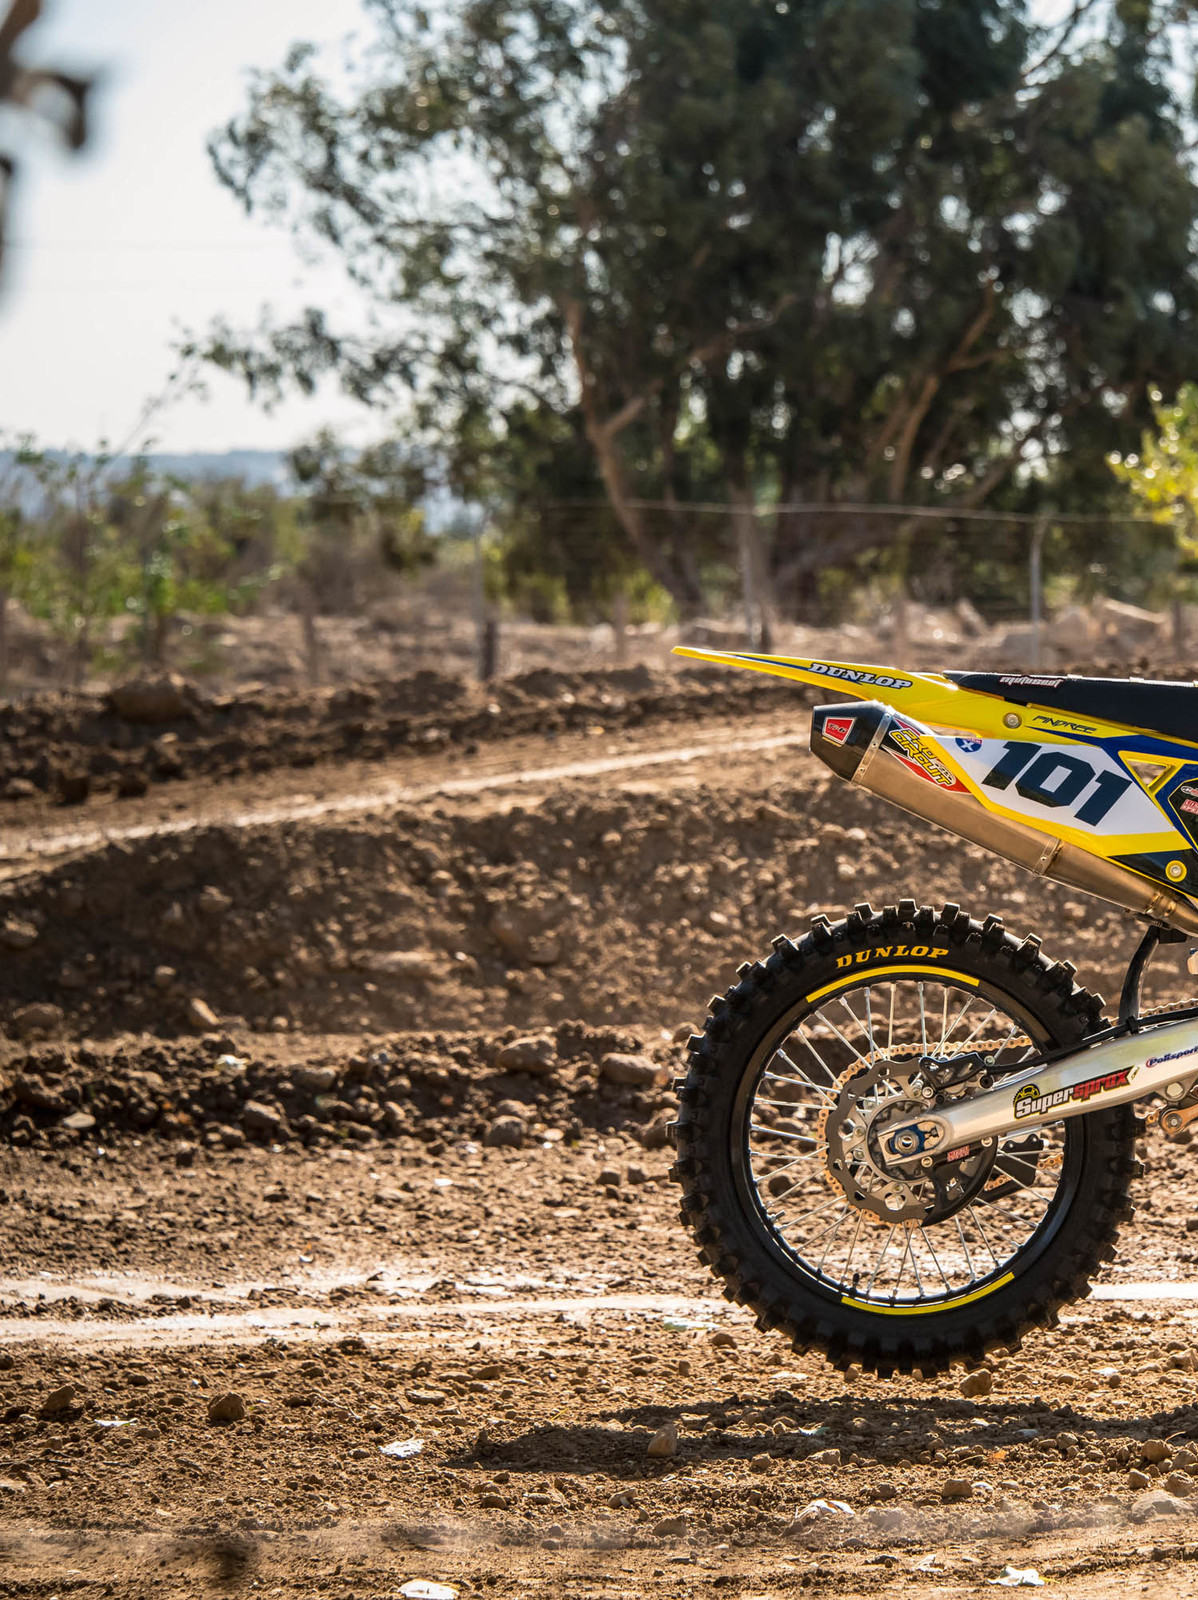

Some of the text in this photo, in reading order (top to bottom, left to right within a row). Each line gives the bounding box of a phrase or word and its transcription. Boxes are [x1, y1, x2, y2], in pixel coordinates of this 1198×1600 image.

[808, 662, 912, 689] DUNLOP
[890, 730, 952, 787] CIRCUIT
[981, 741, 1133, 827] 101
[836, 944, 949, 969] DUNLOP
[1015, 1069, 1128, 1119] Supersprox
